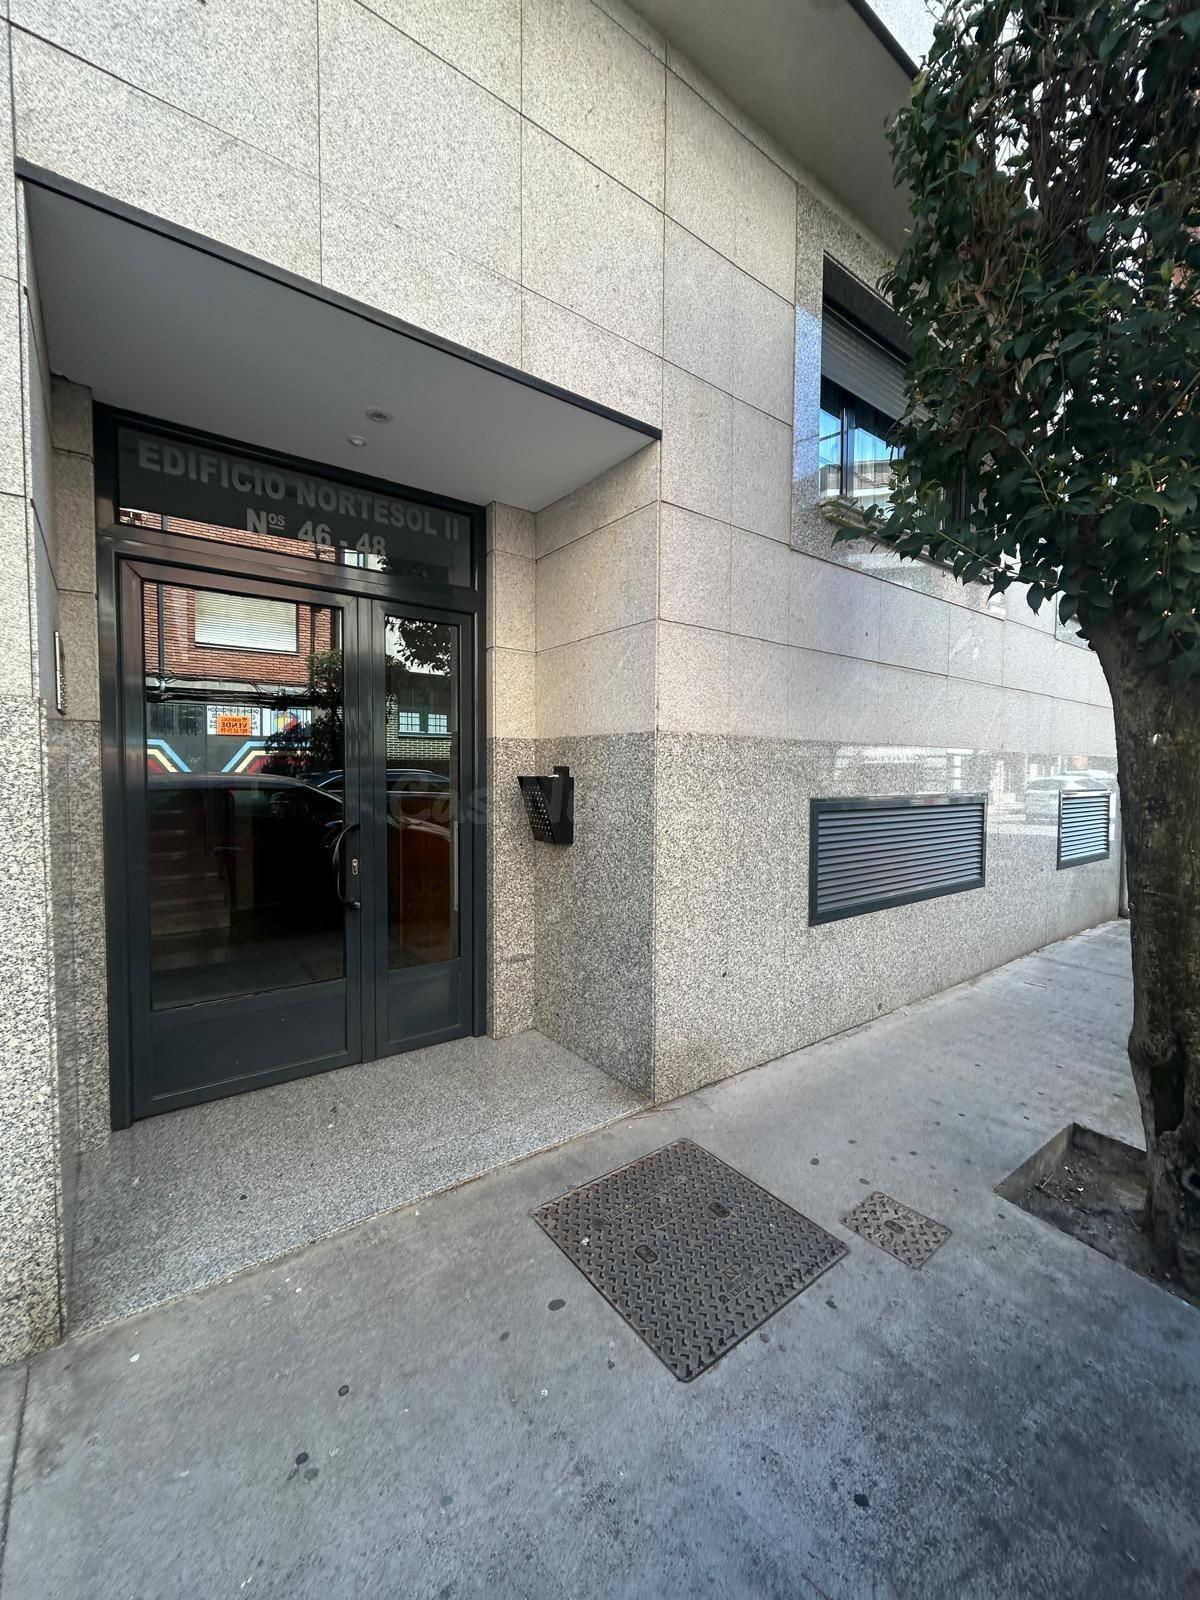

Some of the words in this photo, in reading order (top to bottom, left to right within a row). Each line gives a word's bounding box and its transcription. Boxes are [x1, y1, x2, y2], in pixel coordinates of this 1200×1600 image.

[138, 439, 286, 500] EDIFICIO
[296, 479, 438, 536] NORTESOL
[443, 515, 460, 542] II
[297, 519, 332, 547] 46
